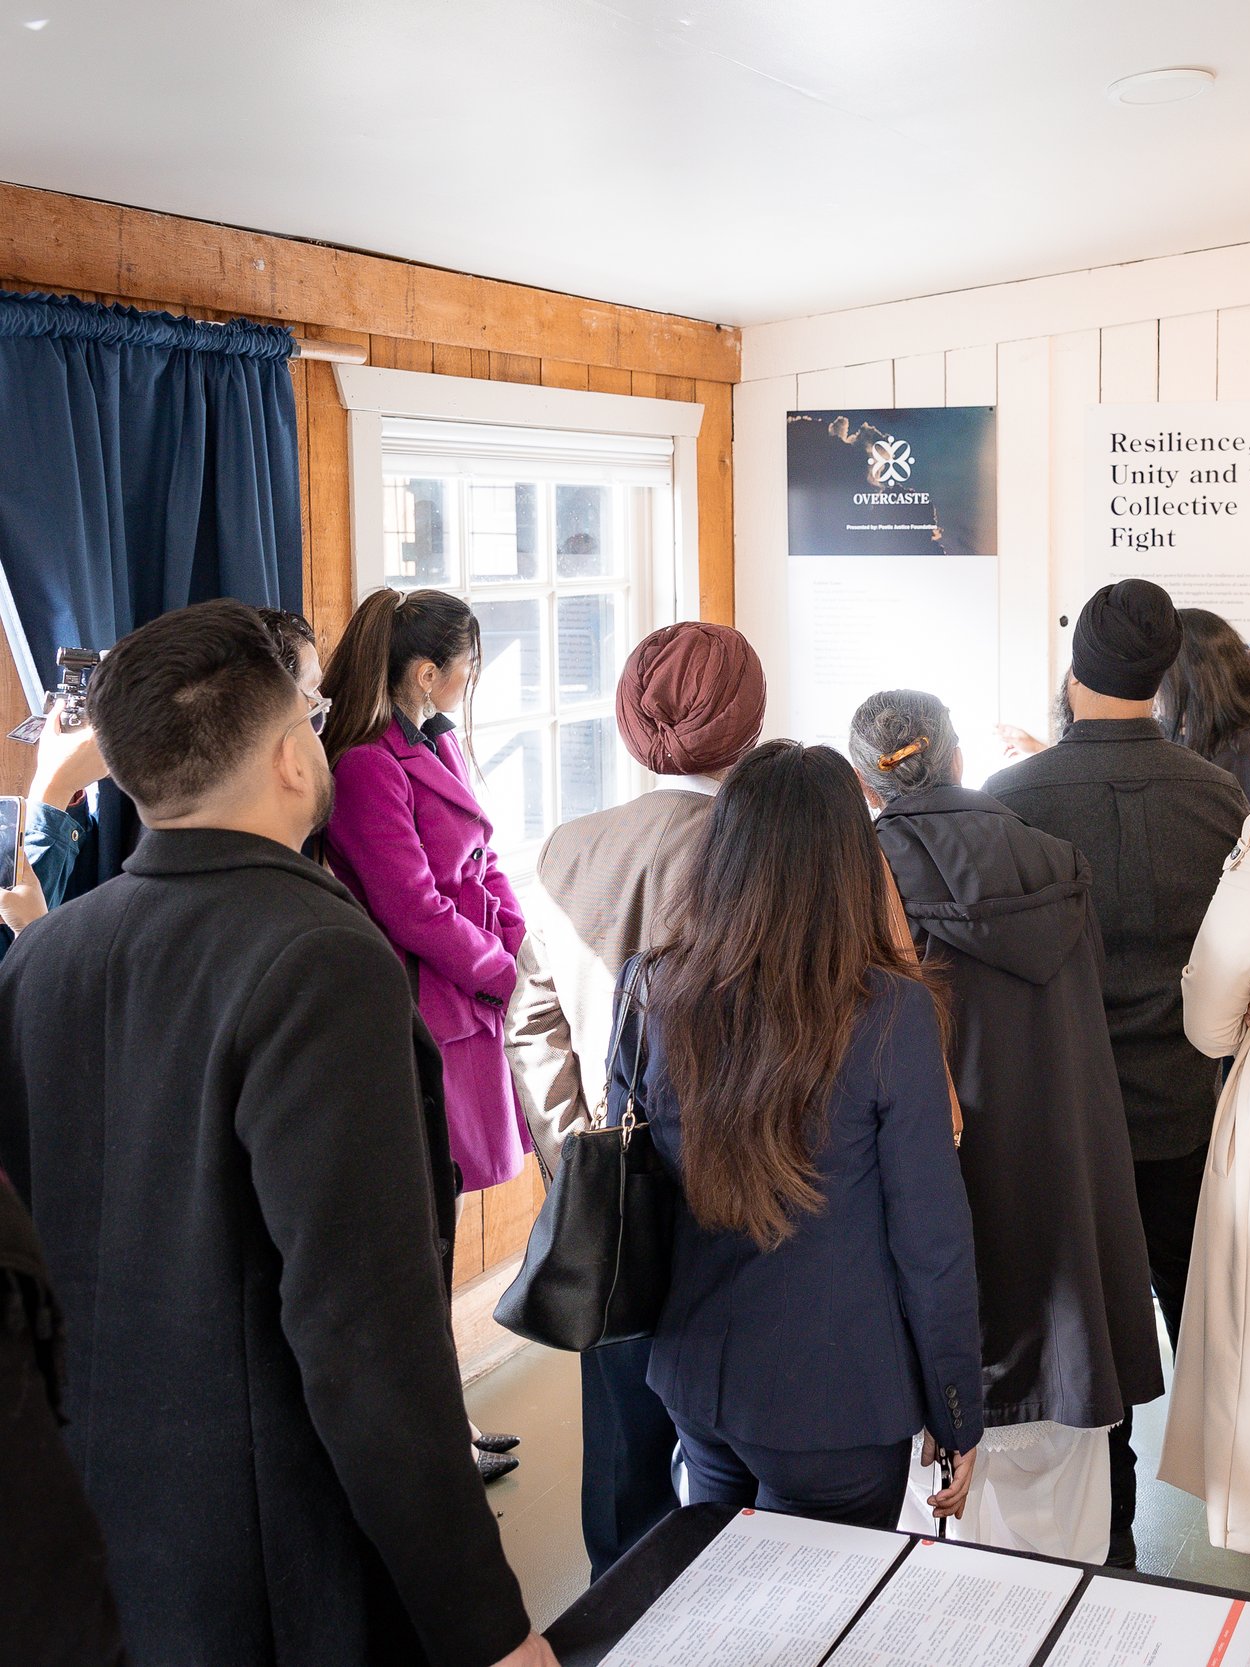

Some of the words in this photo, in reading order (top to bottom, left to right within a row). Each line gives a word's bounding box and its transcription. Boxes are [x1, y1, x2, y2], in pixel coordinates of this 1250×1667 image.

[1111, 464, 1179, 489] Unity
[1189, 463, 1238, 484] and
[853, 492, 930, 505] OVERCASTE
[1110, 495, 1238, 517] Collective
[1111, 527, 1176, 553] Fight
